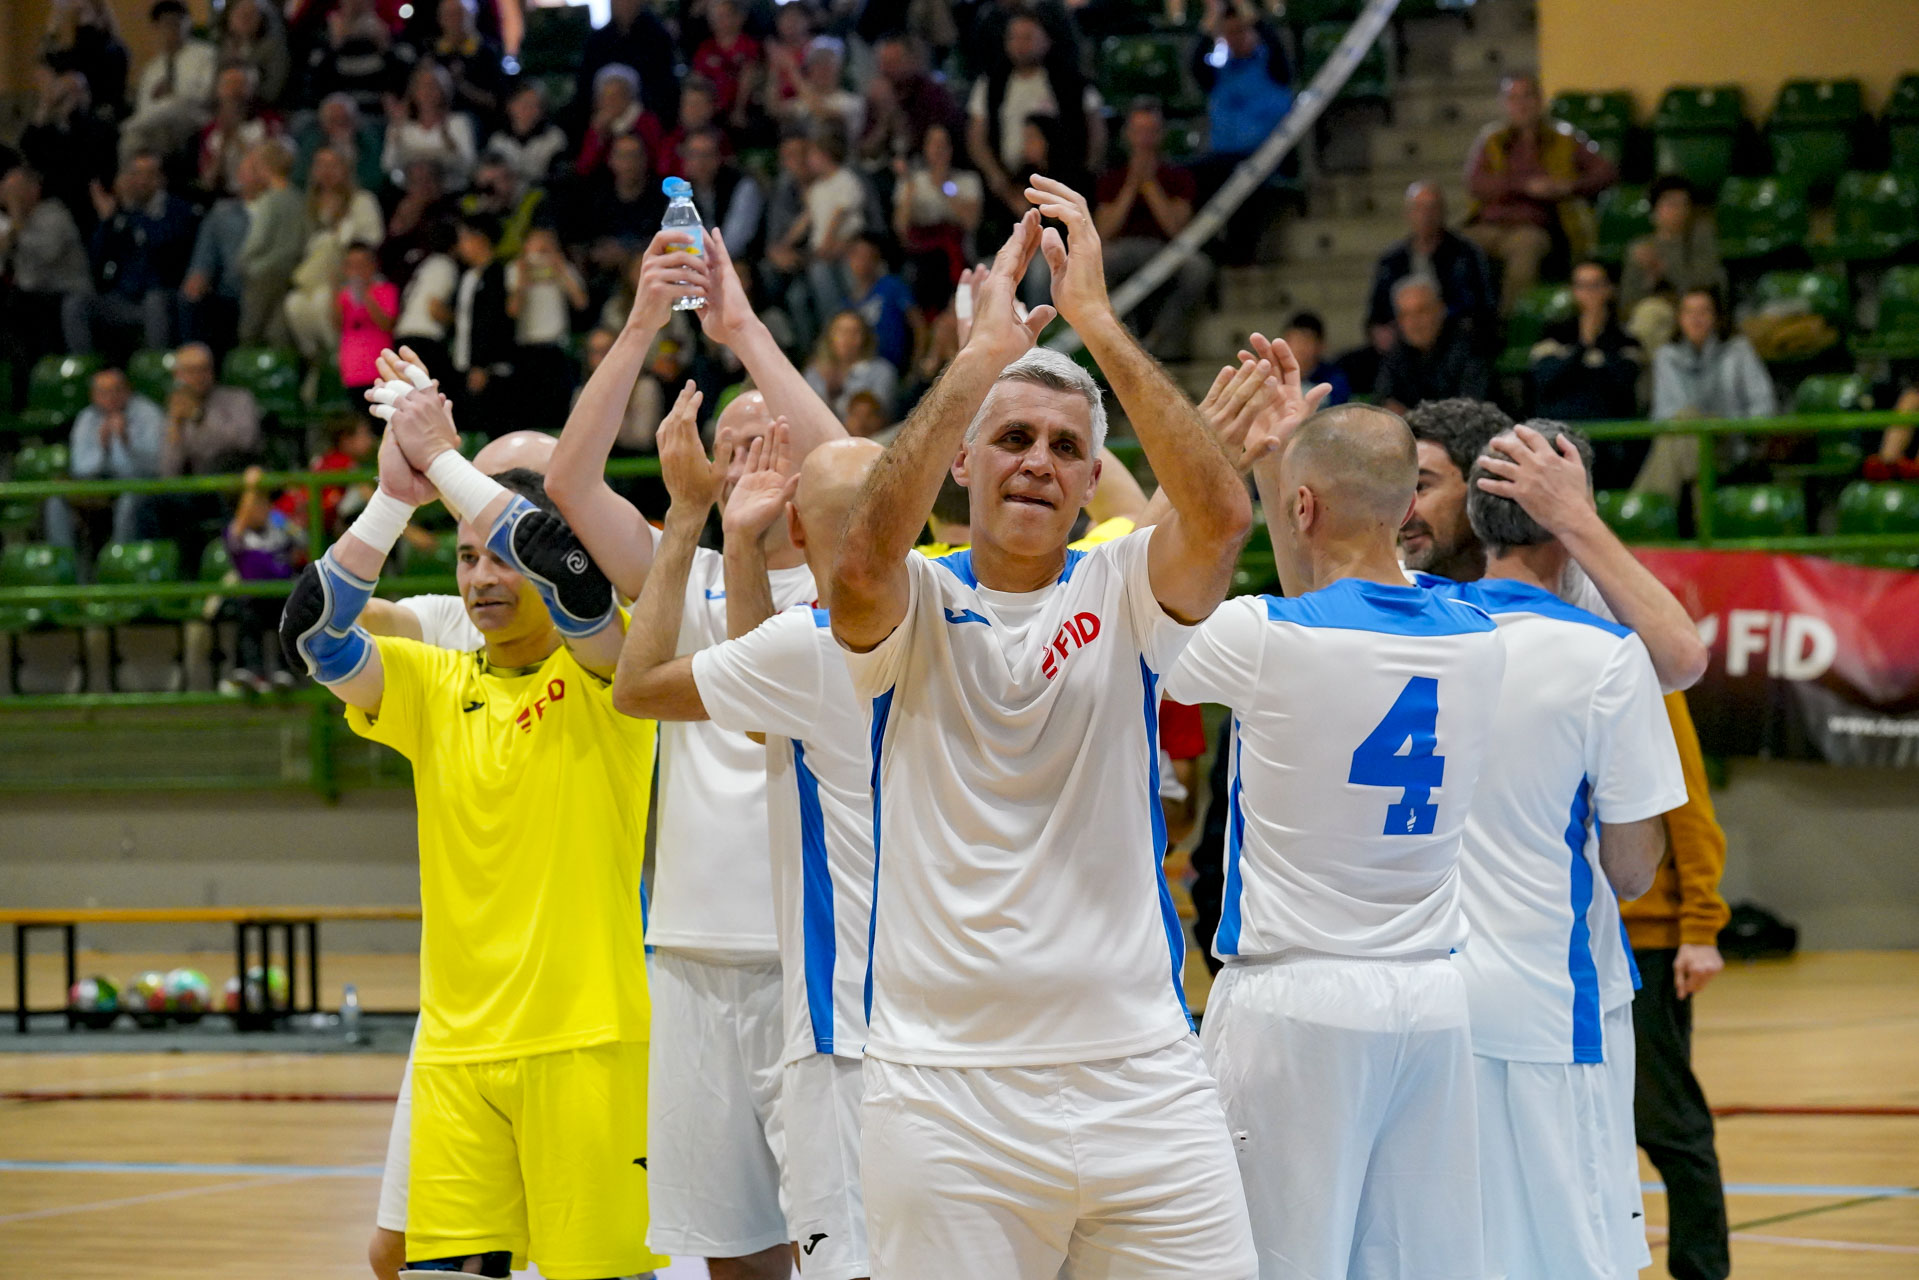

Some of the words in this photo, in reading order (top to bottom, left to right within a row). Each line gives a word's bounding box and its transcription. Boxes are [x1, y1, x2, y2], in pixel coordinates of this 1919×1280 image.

[1052, 611, 1102, 660] FID
[1726, 609, 1837, 681] FID
[1348, 675, 1445, 836] 4
